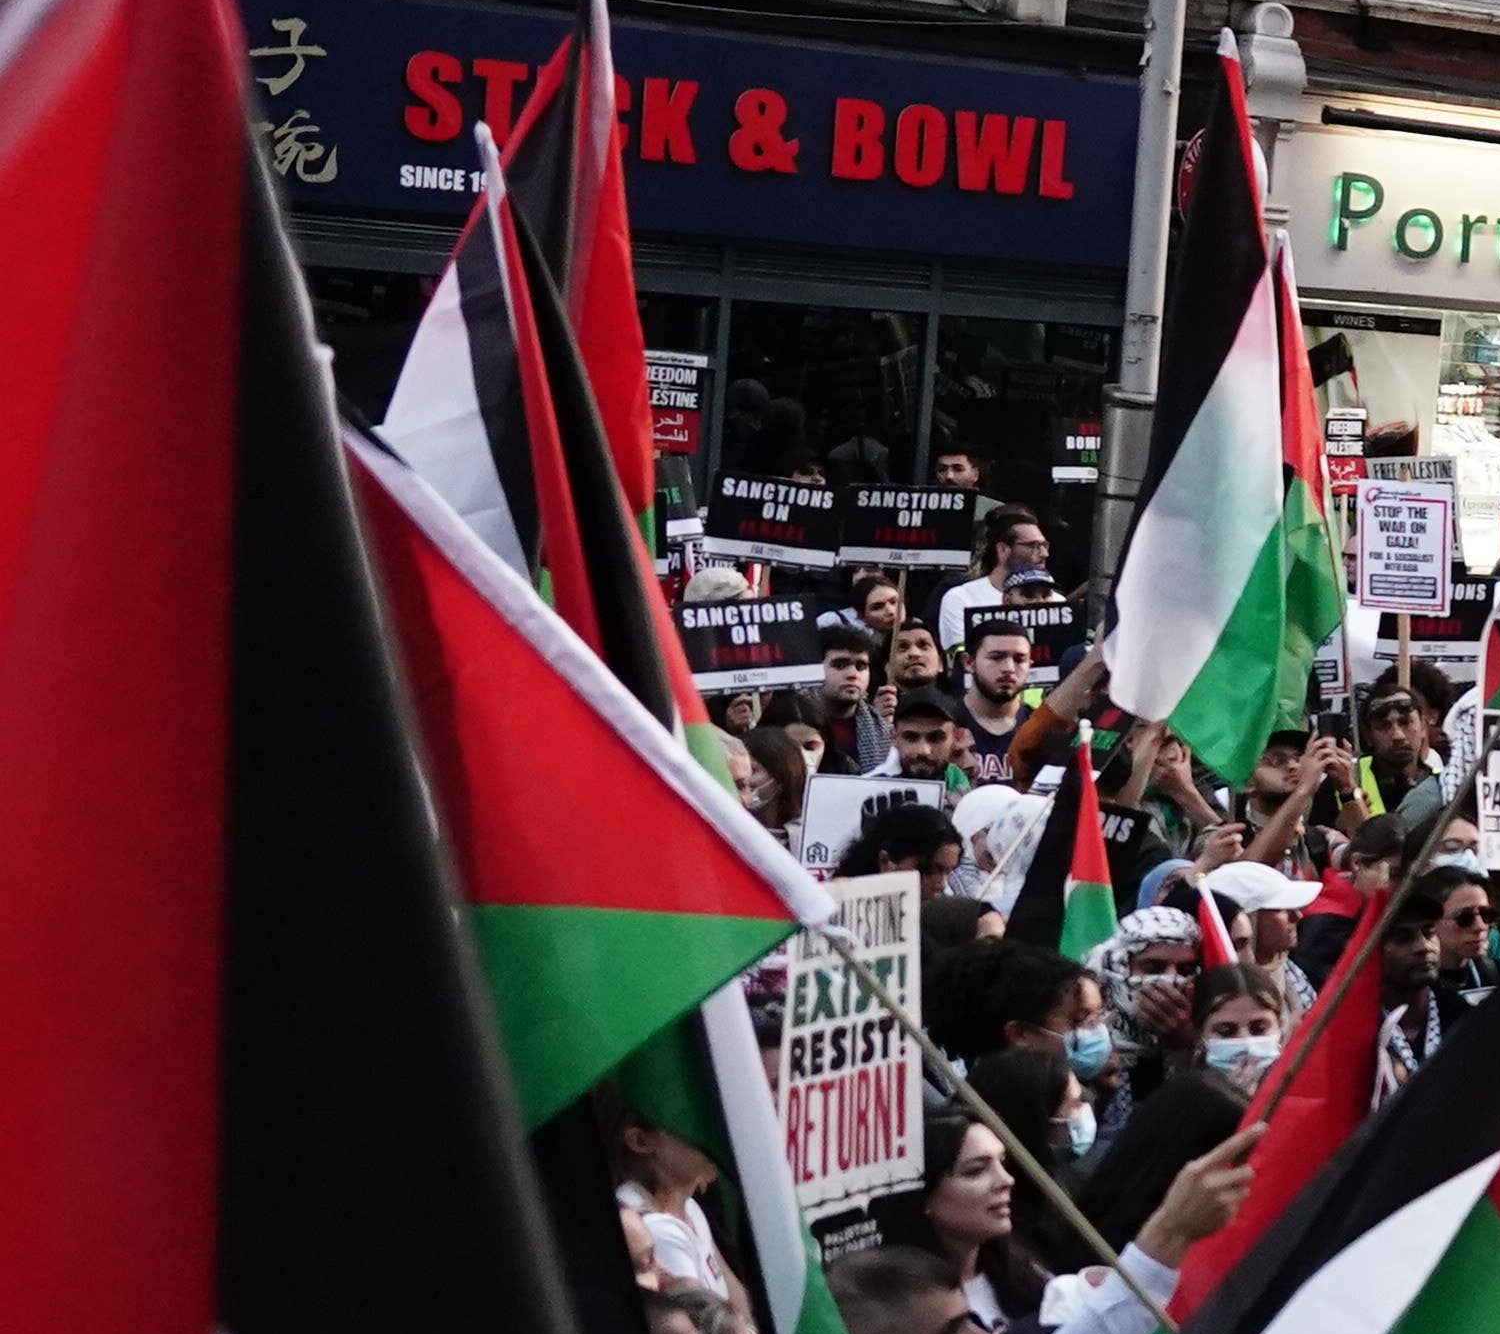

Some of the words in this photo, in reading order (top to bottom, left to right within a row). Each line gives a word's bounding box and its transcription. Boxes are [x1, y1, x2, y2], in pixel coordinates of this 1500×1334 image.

[404, 50, 699, 165] STK
[728, 88, 800, 174] &
[832, 97, 1076, 201] BOWL
[400, 165, 466, 192] SINCE
[722, 477, 834, 508] SANCTIONS
[857, 491, 965, 510] SANCTIONS
[763, 502, 789, 522] ON
[897, 510, 922, 527] ON
[1374, 505, 1404, 519] STOP
[1406, 506, 1428, 519] THE
[682, 602, 804, 629] SANCTIONS
[731, 625, 760, 645] ON
[790, 1018, 907, 1082] RESIST!
[786, 1061, 907, 1185] RETURN!
